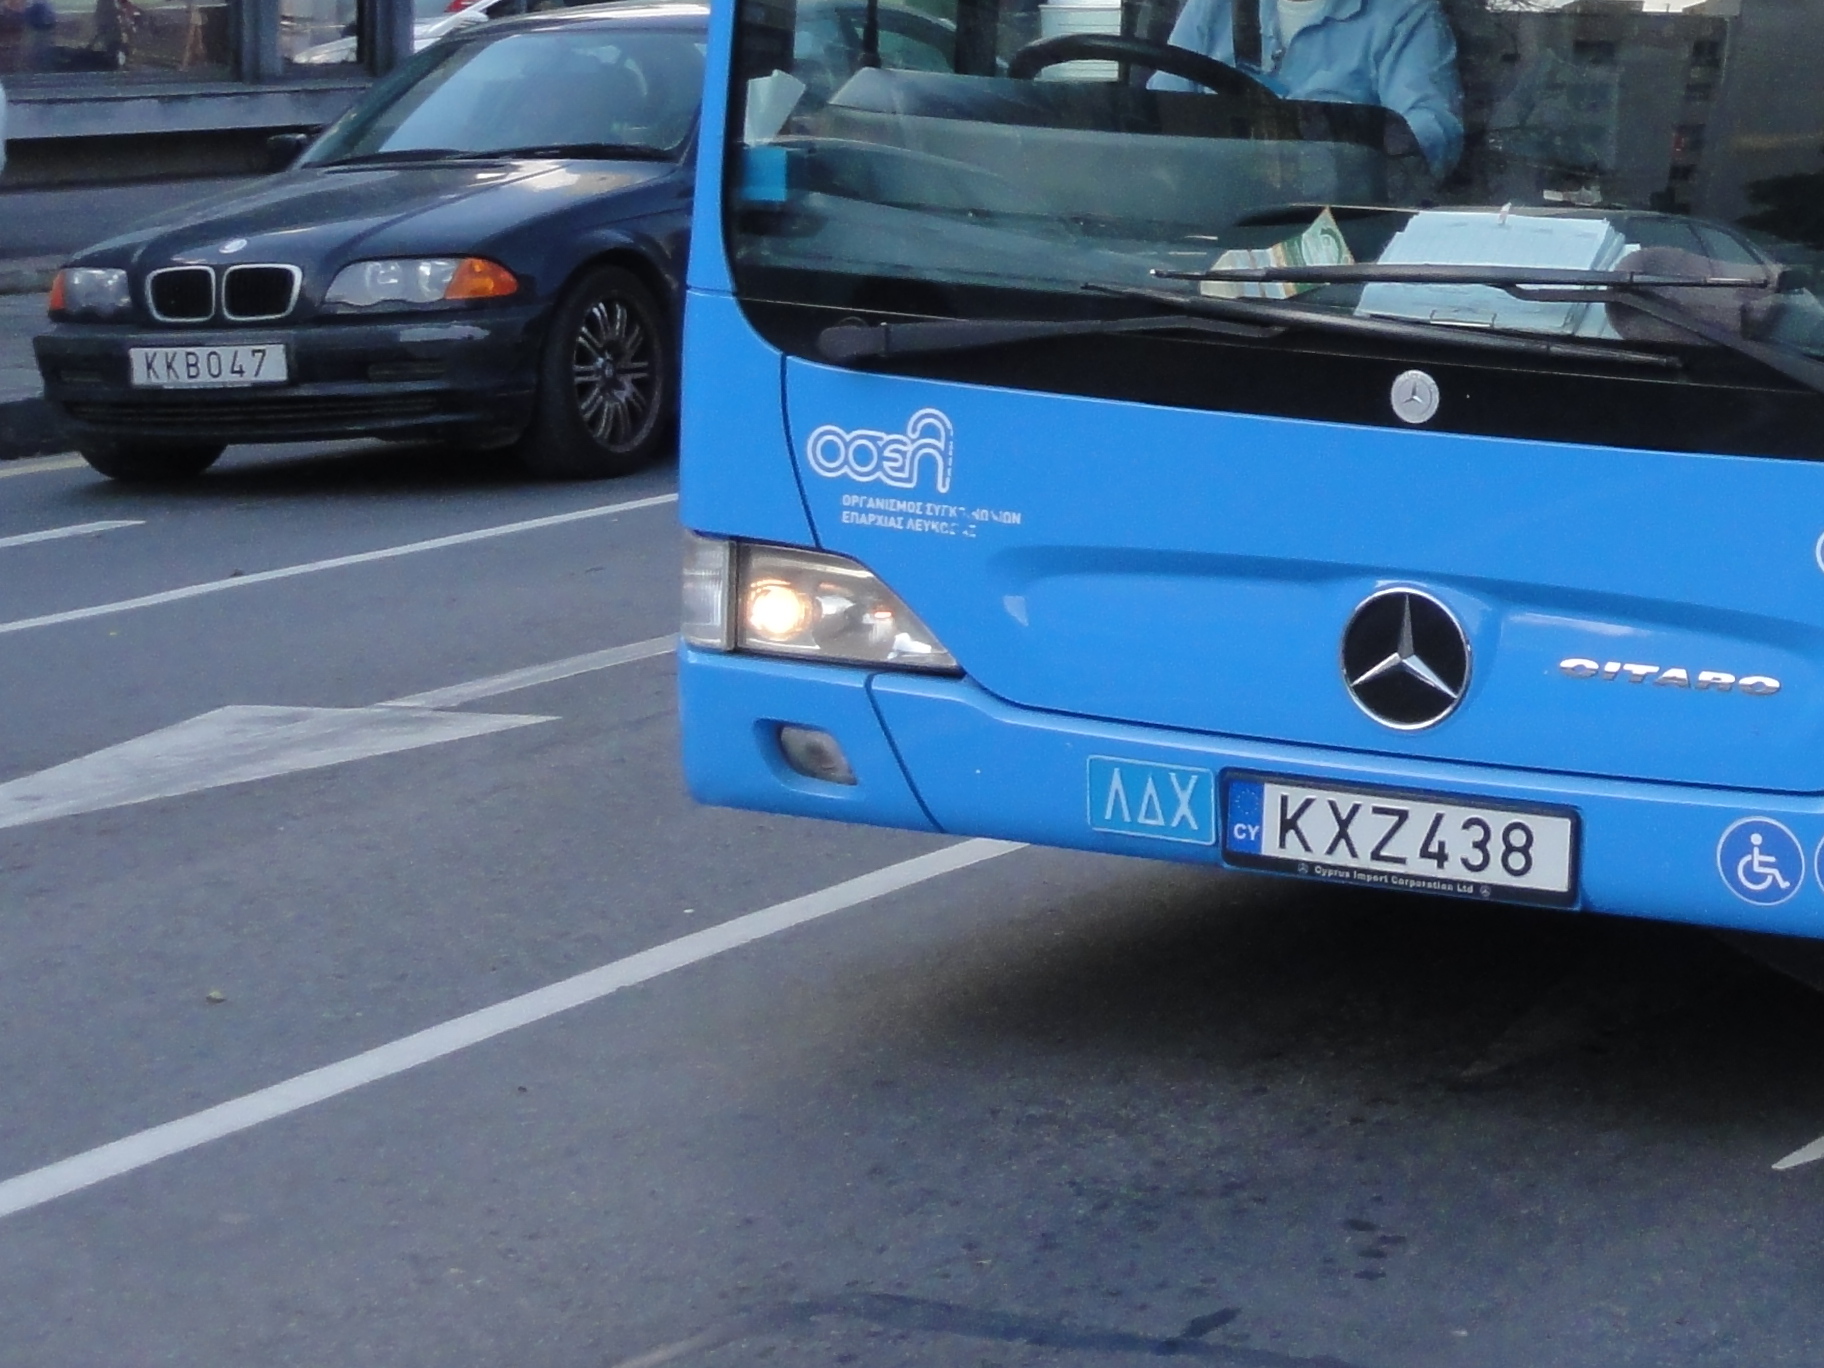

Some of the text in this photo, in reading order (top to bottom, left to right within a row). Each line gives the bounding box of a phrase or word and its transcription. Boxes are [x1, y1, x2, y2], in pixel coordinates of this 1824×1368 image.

[145, 349, 267, 380] KKB047
[1559, 657, 1781, 696] CITARO
[1233, 792, 1535, 878] CY KXZ438
[1314, 865, 1350, 879] Cyprus
[1353, 870, 1389, 883] Import
[1456, 883, 1474, 894] Ltd
